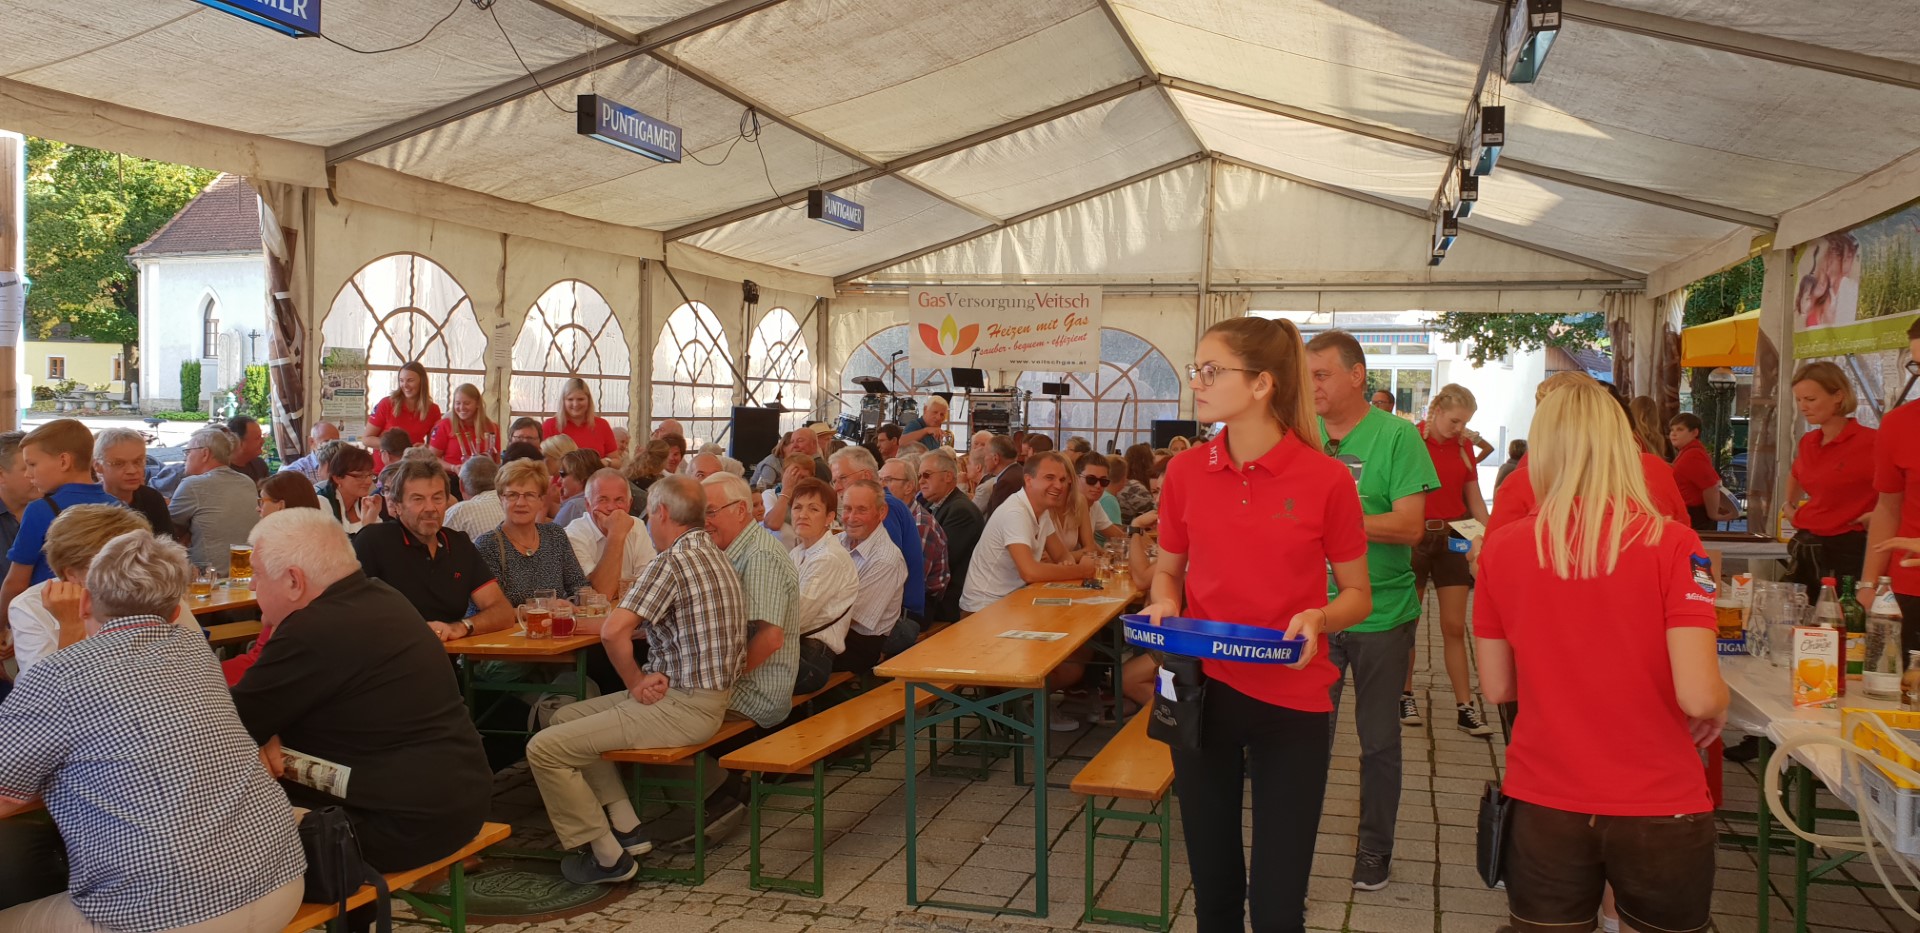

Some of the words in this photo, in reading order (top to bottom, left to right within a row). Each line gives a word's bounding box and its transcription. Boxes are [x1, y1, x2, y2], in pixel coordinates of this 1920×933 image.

[602, 102, 677, 153] PUNTIGAMER
[824, 195, 862, 225] PUNTIGAMER
[918, 291, 1090, 311] GasVersorgungVeitsch
[987, 323, 1031, 340] Heizen
[1036, 318, 1059, 332] mit
[1063, 312, 1089, 332] Gas
[979, 343, 1007, 355] sauber
[1013, 340, 1045, 352] bequem
[1051, 332, 1088, 347] effizient
[1211, 641, 1292, 660] PUNTIGAMER
